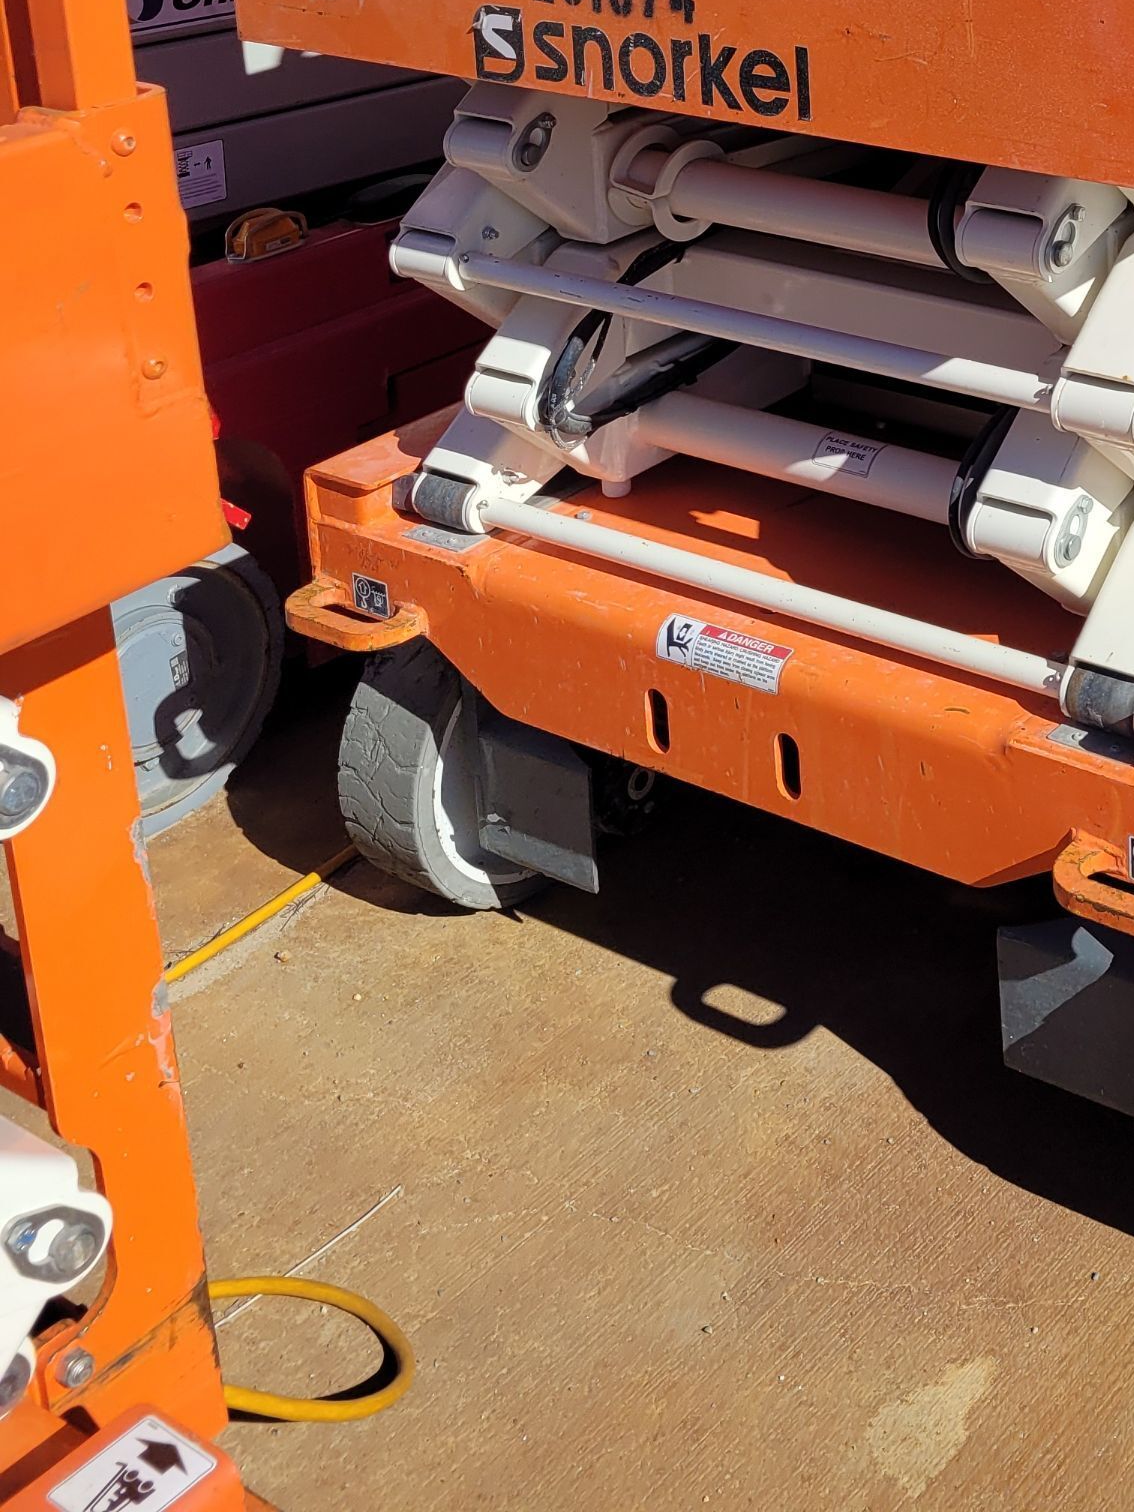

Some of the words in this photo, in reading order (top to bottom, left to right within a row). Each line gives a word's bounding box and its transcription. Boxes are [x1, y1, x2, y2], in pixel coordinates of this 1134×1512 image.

[532, 21, 813, 121] snorkel
[847, 451, 866, 461] HERE
[727, 631, 775, 653] DANGER
